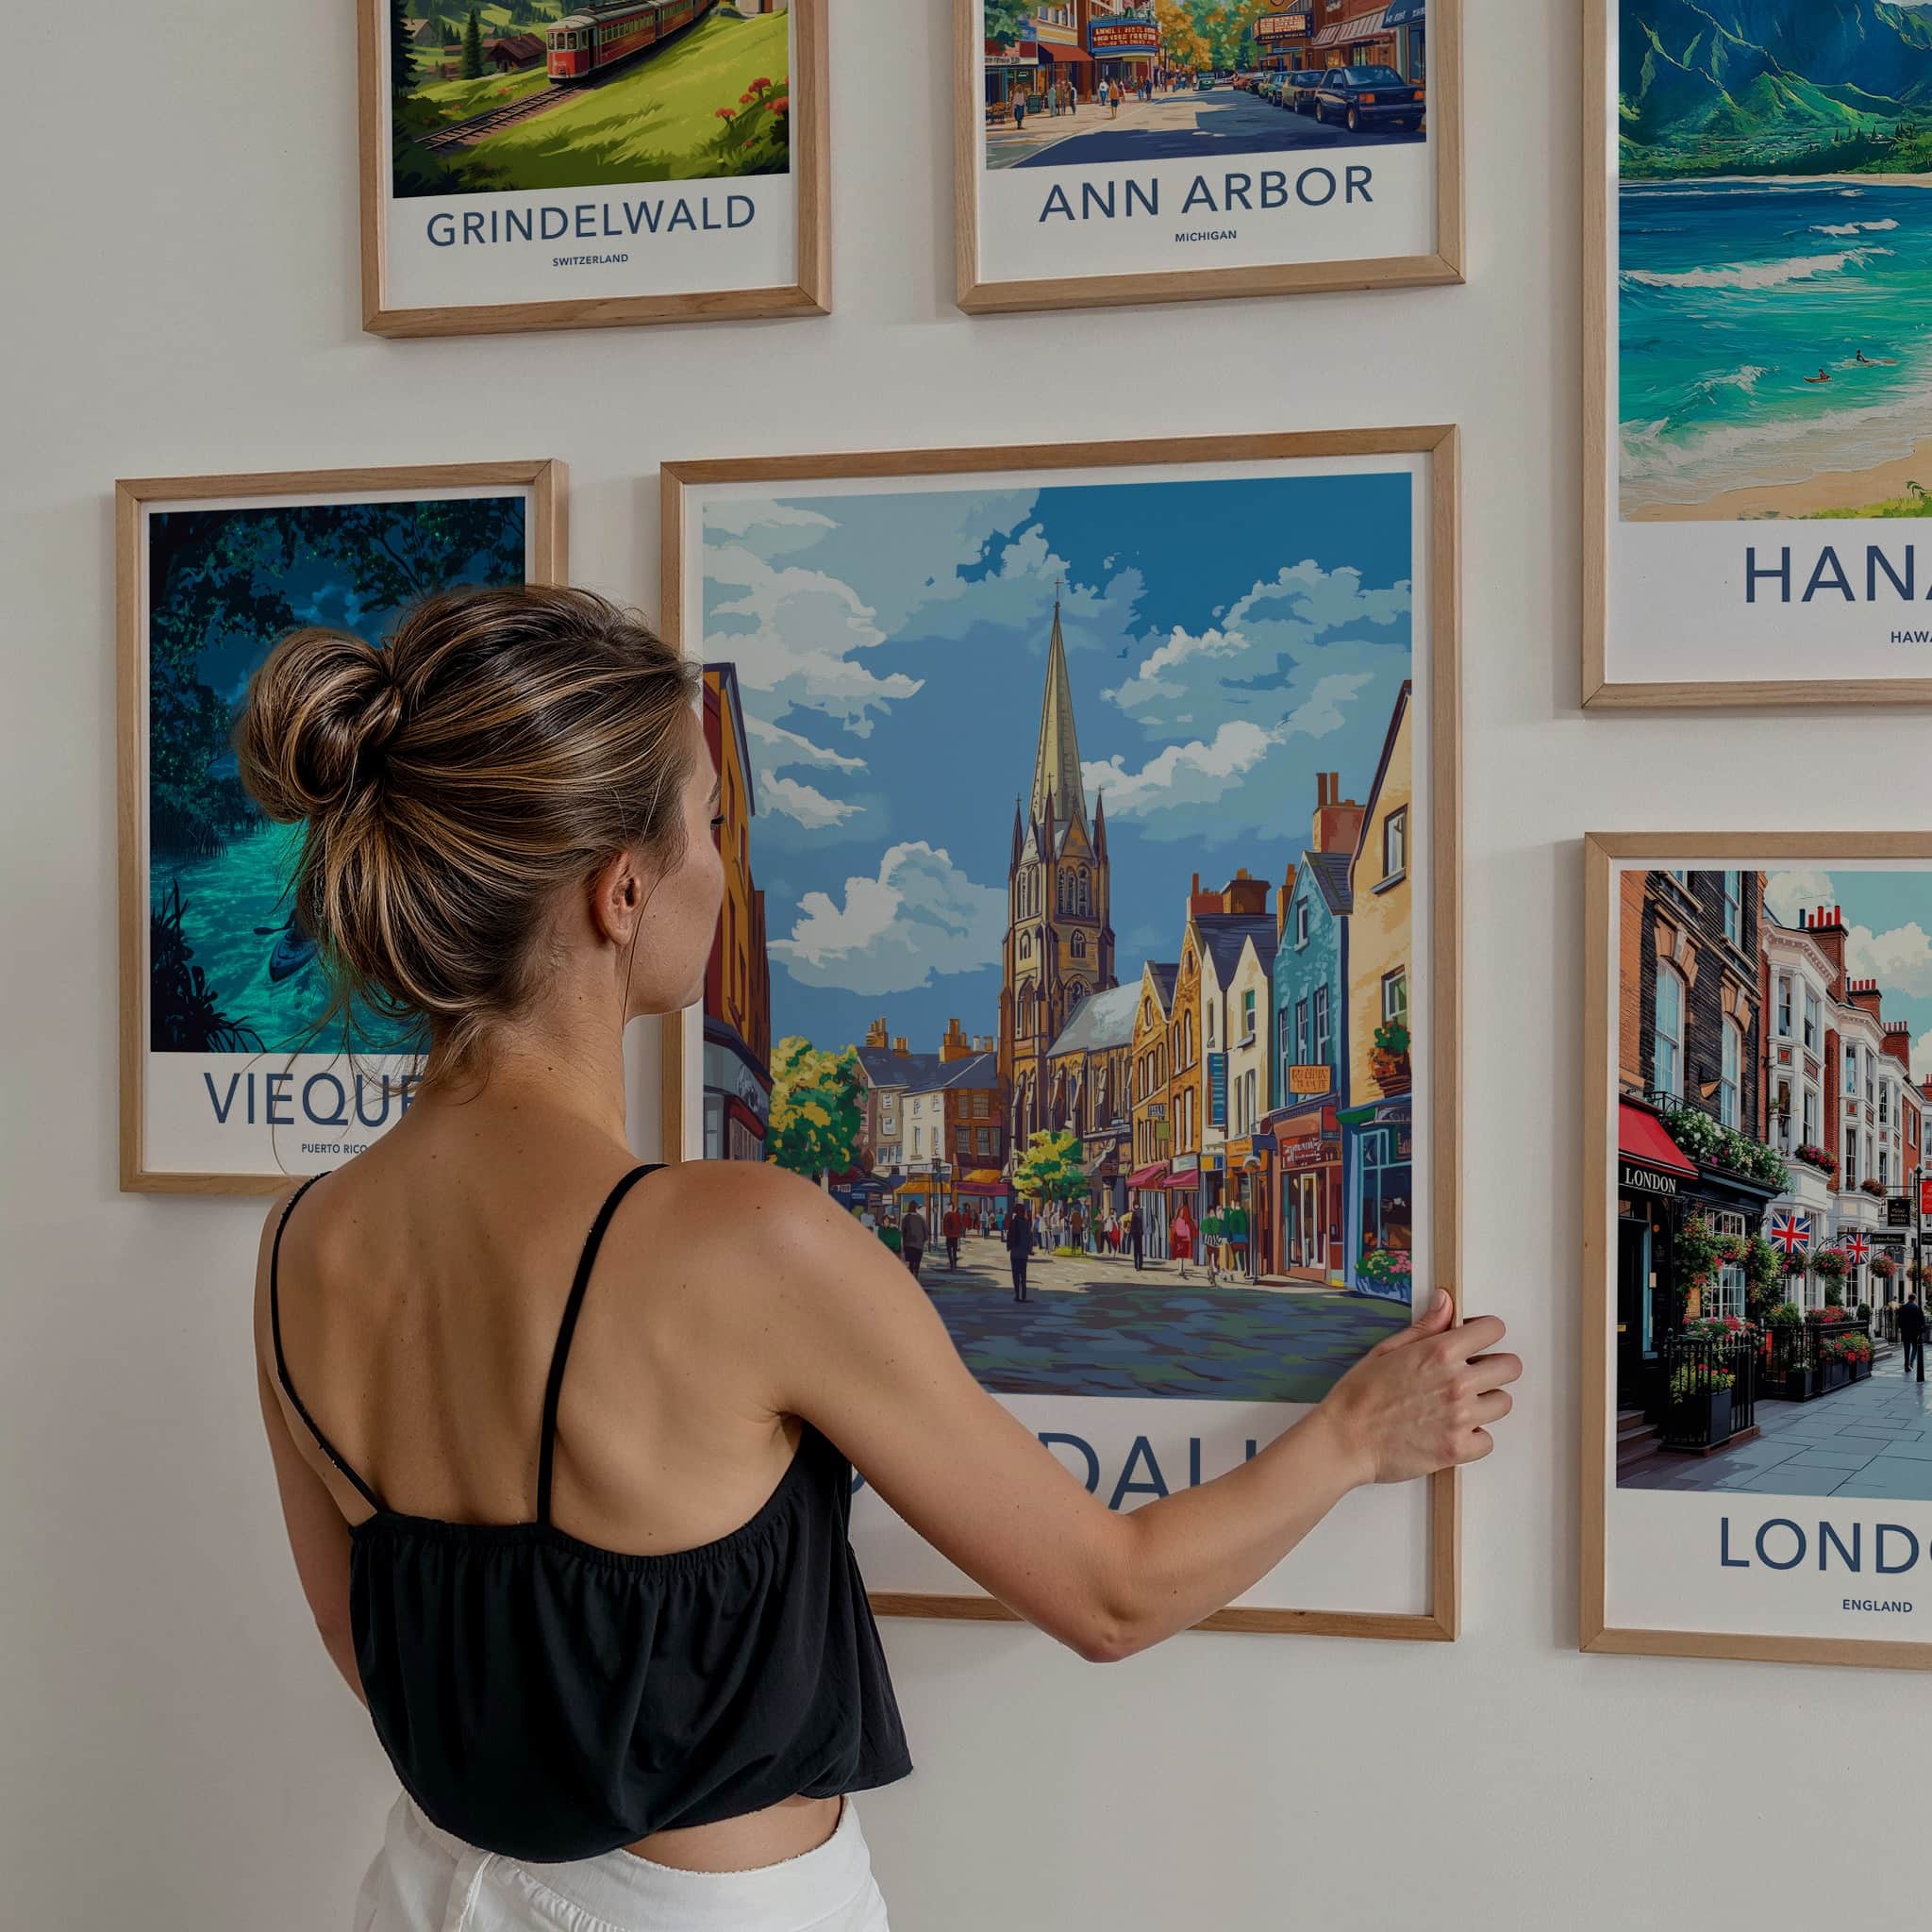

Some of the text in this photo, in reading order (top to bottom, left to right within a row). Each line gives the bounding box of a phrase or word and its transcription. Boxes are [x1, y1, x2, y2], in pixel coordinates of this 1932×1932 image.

[1039, 165, 1374, 223] ANN ARBOR
[427, 195, 756, 246] GRINDELWALD
[1174, 229, 1237, 242] MICHIGAN
[552, 254, 629, 267] SWITZERLAND
[1746, 545, 1932, 603] HAN
[1890, 630, 1932, 643] HAW
[301, 1143, 341, 1154] PUERTO
[1624, 1168, 1676, 1194] LONDON
[1721, 1517, 1932, 1574] LOND
[1842, 1599, 1913, 1613] ENGLAND
